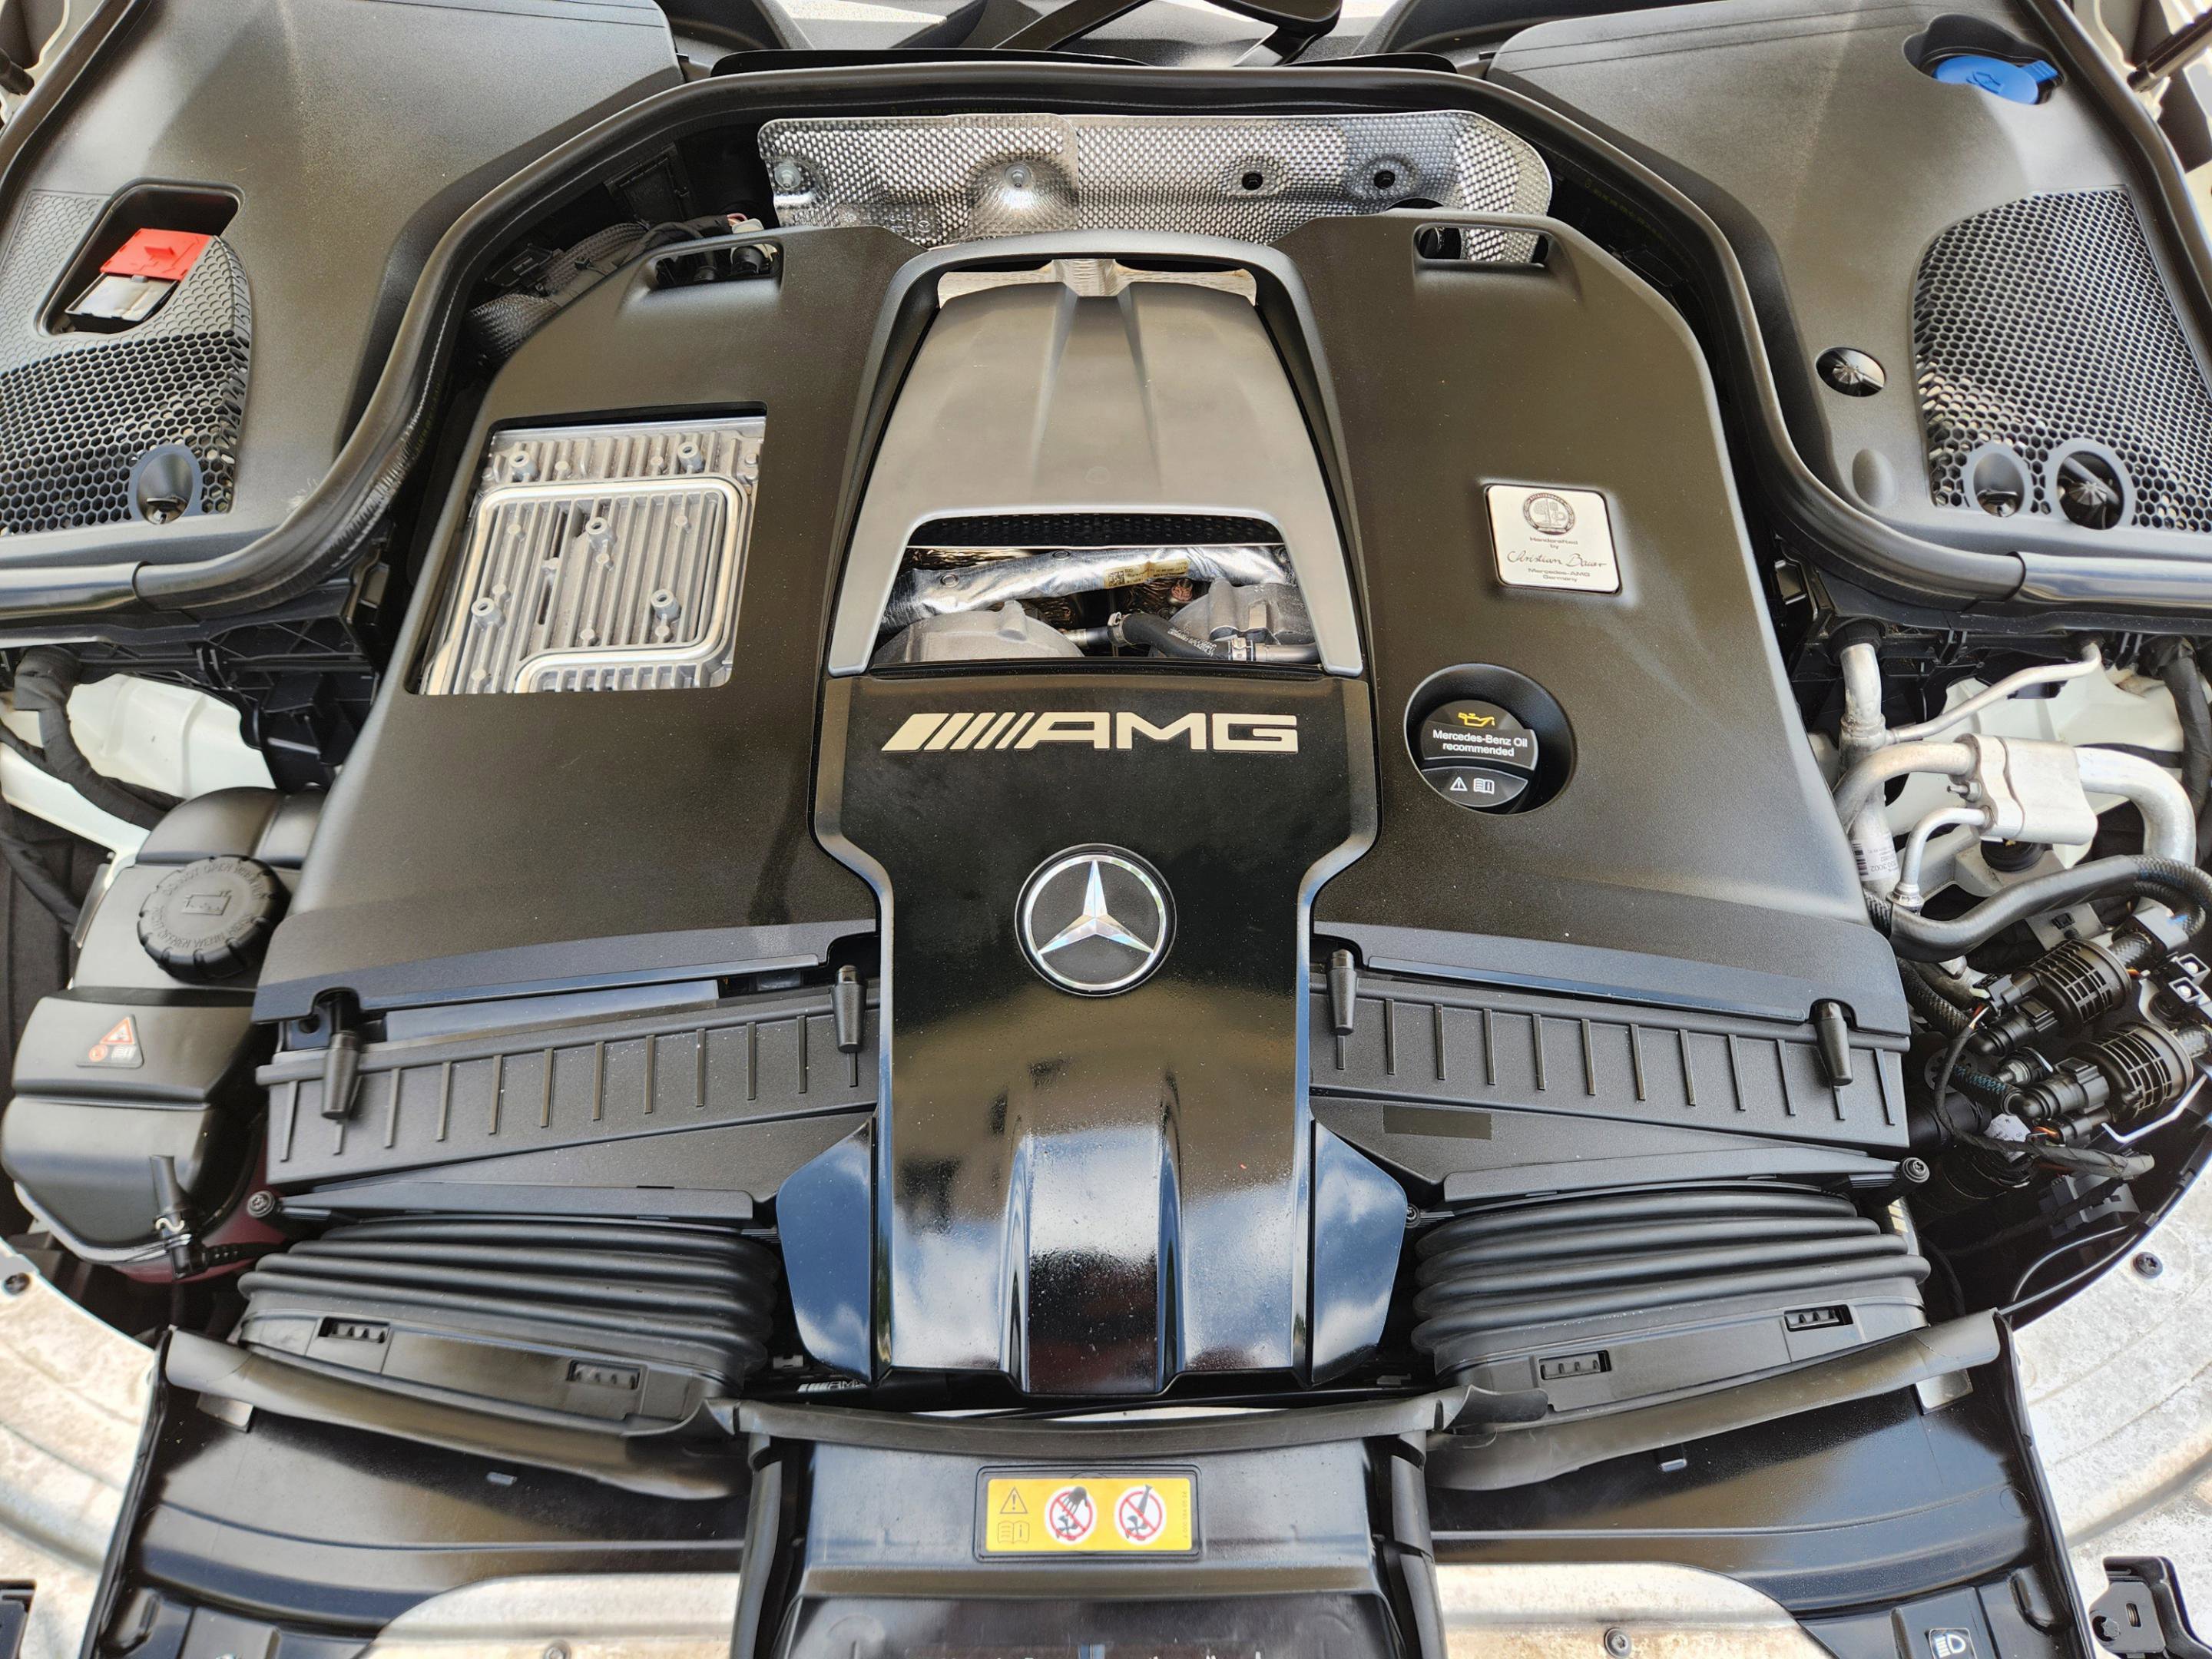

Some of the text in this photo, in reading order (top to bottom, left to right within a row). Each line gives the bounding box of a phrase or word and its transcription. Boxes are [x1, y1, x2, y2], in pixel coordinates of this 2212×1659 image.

[1529, 537, 1578, 545] Handcrafted
[1528, 568, 1591, 577] Mercedes-AMG
[1014, 711, 1299, 753] AMG
[1432, 729, 1528, 747] Mercedes-Benz Oil
[1442, 742, 1515, 757] recommended
